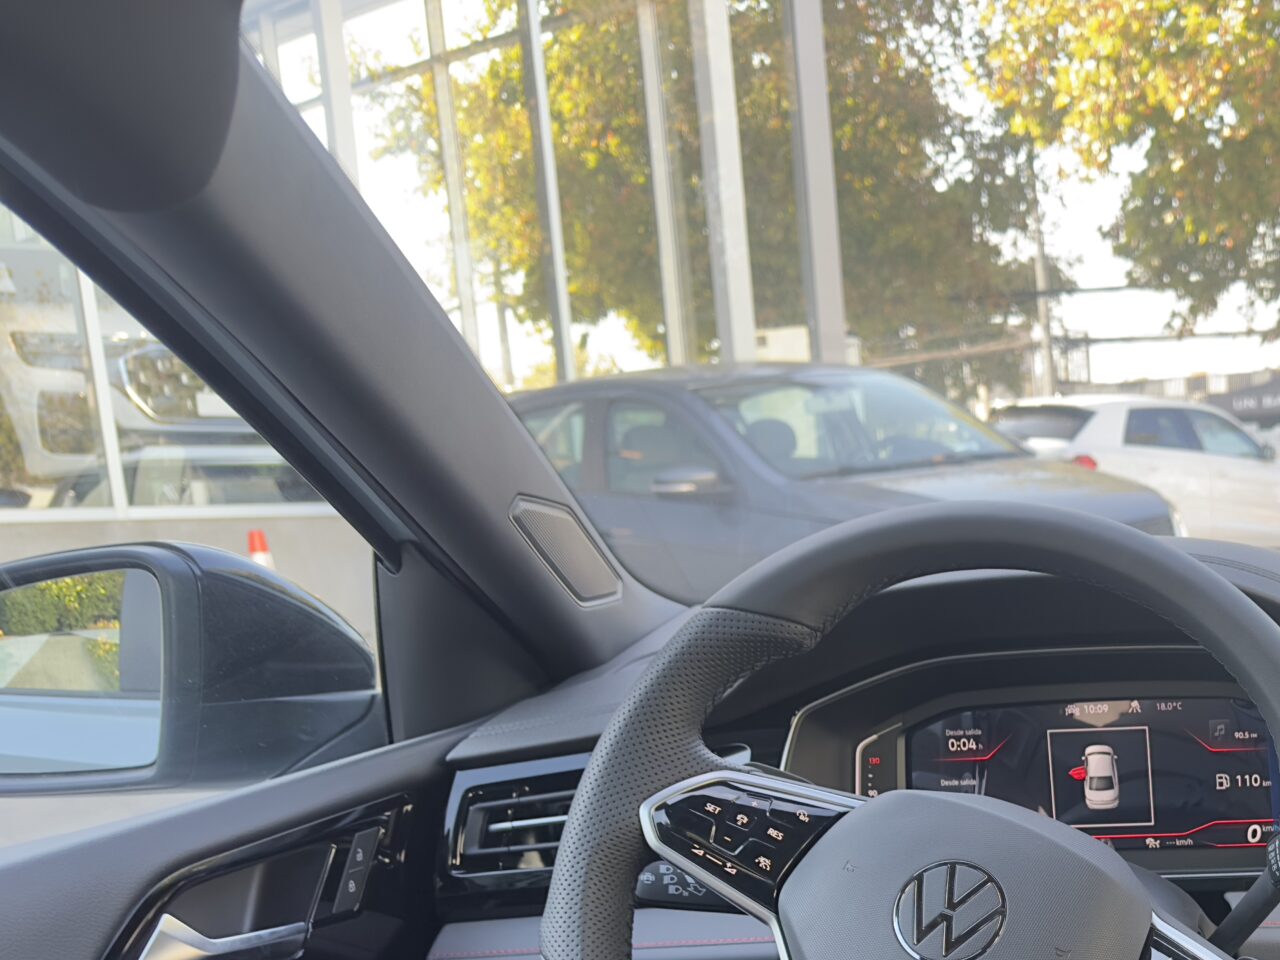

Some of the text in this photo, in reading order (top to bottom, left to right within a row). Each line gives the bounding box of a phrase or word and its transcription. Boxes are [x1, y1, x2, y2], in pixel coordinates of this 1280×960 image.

[1083, 704, 1109, 714] 10:09
[1234, 731, 1249, 739] 90.5
[948, 738, 977, 751] 0:04
[869, 757, 881, 765] 130
[940, 779, 959, 787] Desde
[1236, 774, 1272, 787] 110 km
[704, 802, 722, 815] SET
[766, 827, 785, 841] RES
[1247, 824, 1262, 843] 0
